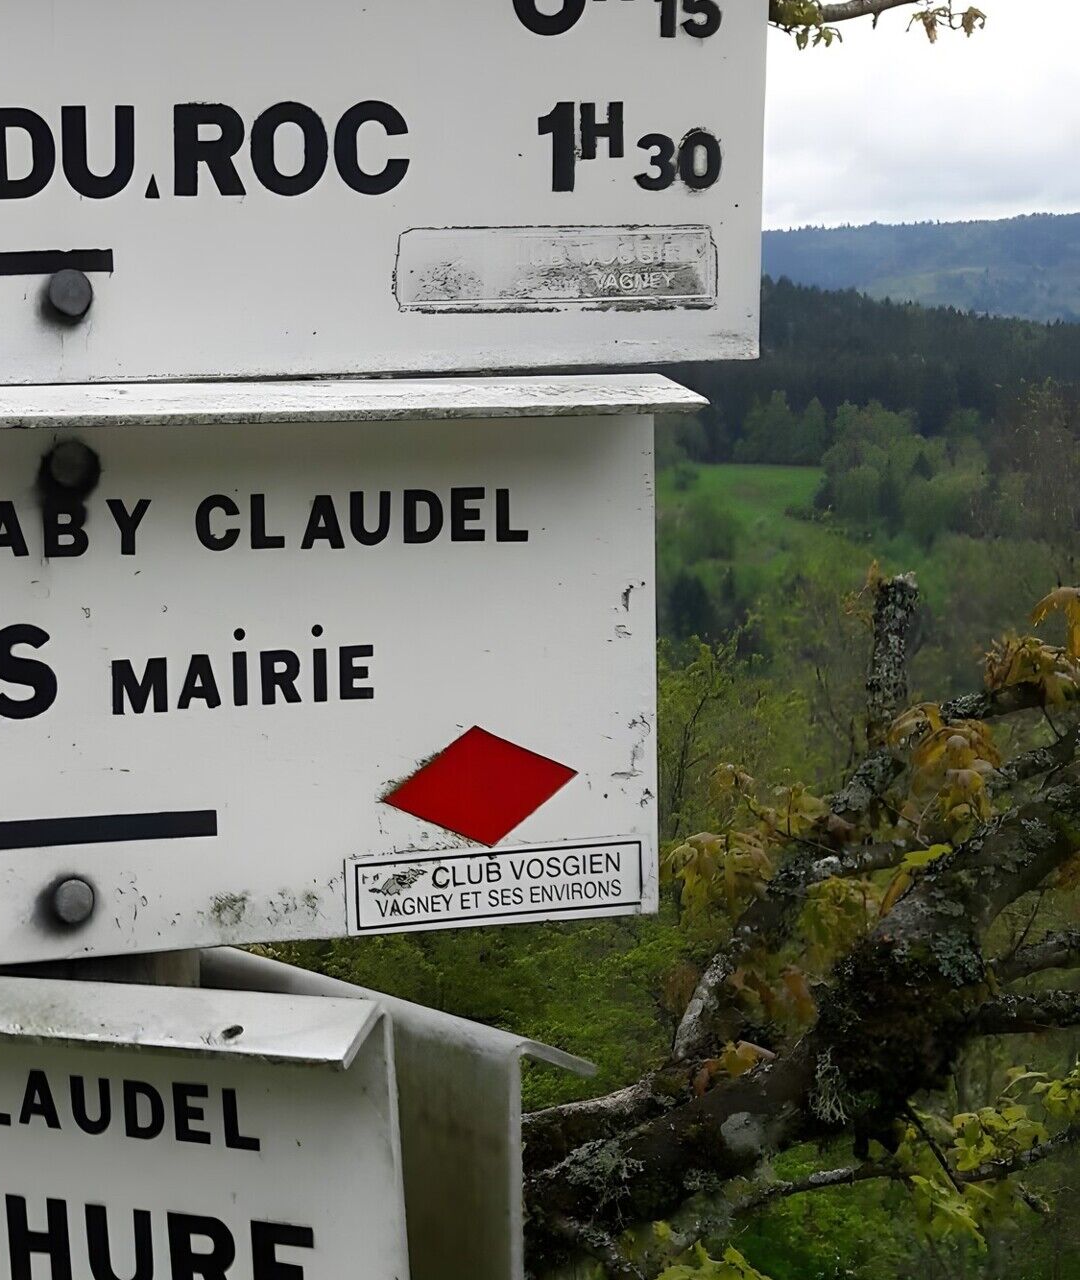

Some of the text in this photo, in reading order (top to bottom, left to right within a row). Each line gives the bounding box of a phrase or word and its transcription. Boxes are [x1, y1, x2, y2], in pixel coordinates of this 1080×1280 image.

[596, 272, 676, 290] VAGNEY
[196, 487, 528, 551] CLAUDEL
[432, 852, 621, 888] CLUB VOSGIEN
[376, 879, 622, 917] VAGNEY ET SES ENVIRONS
